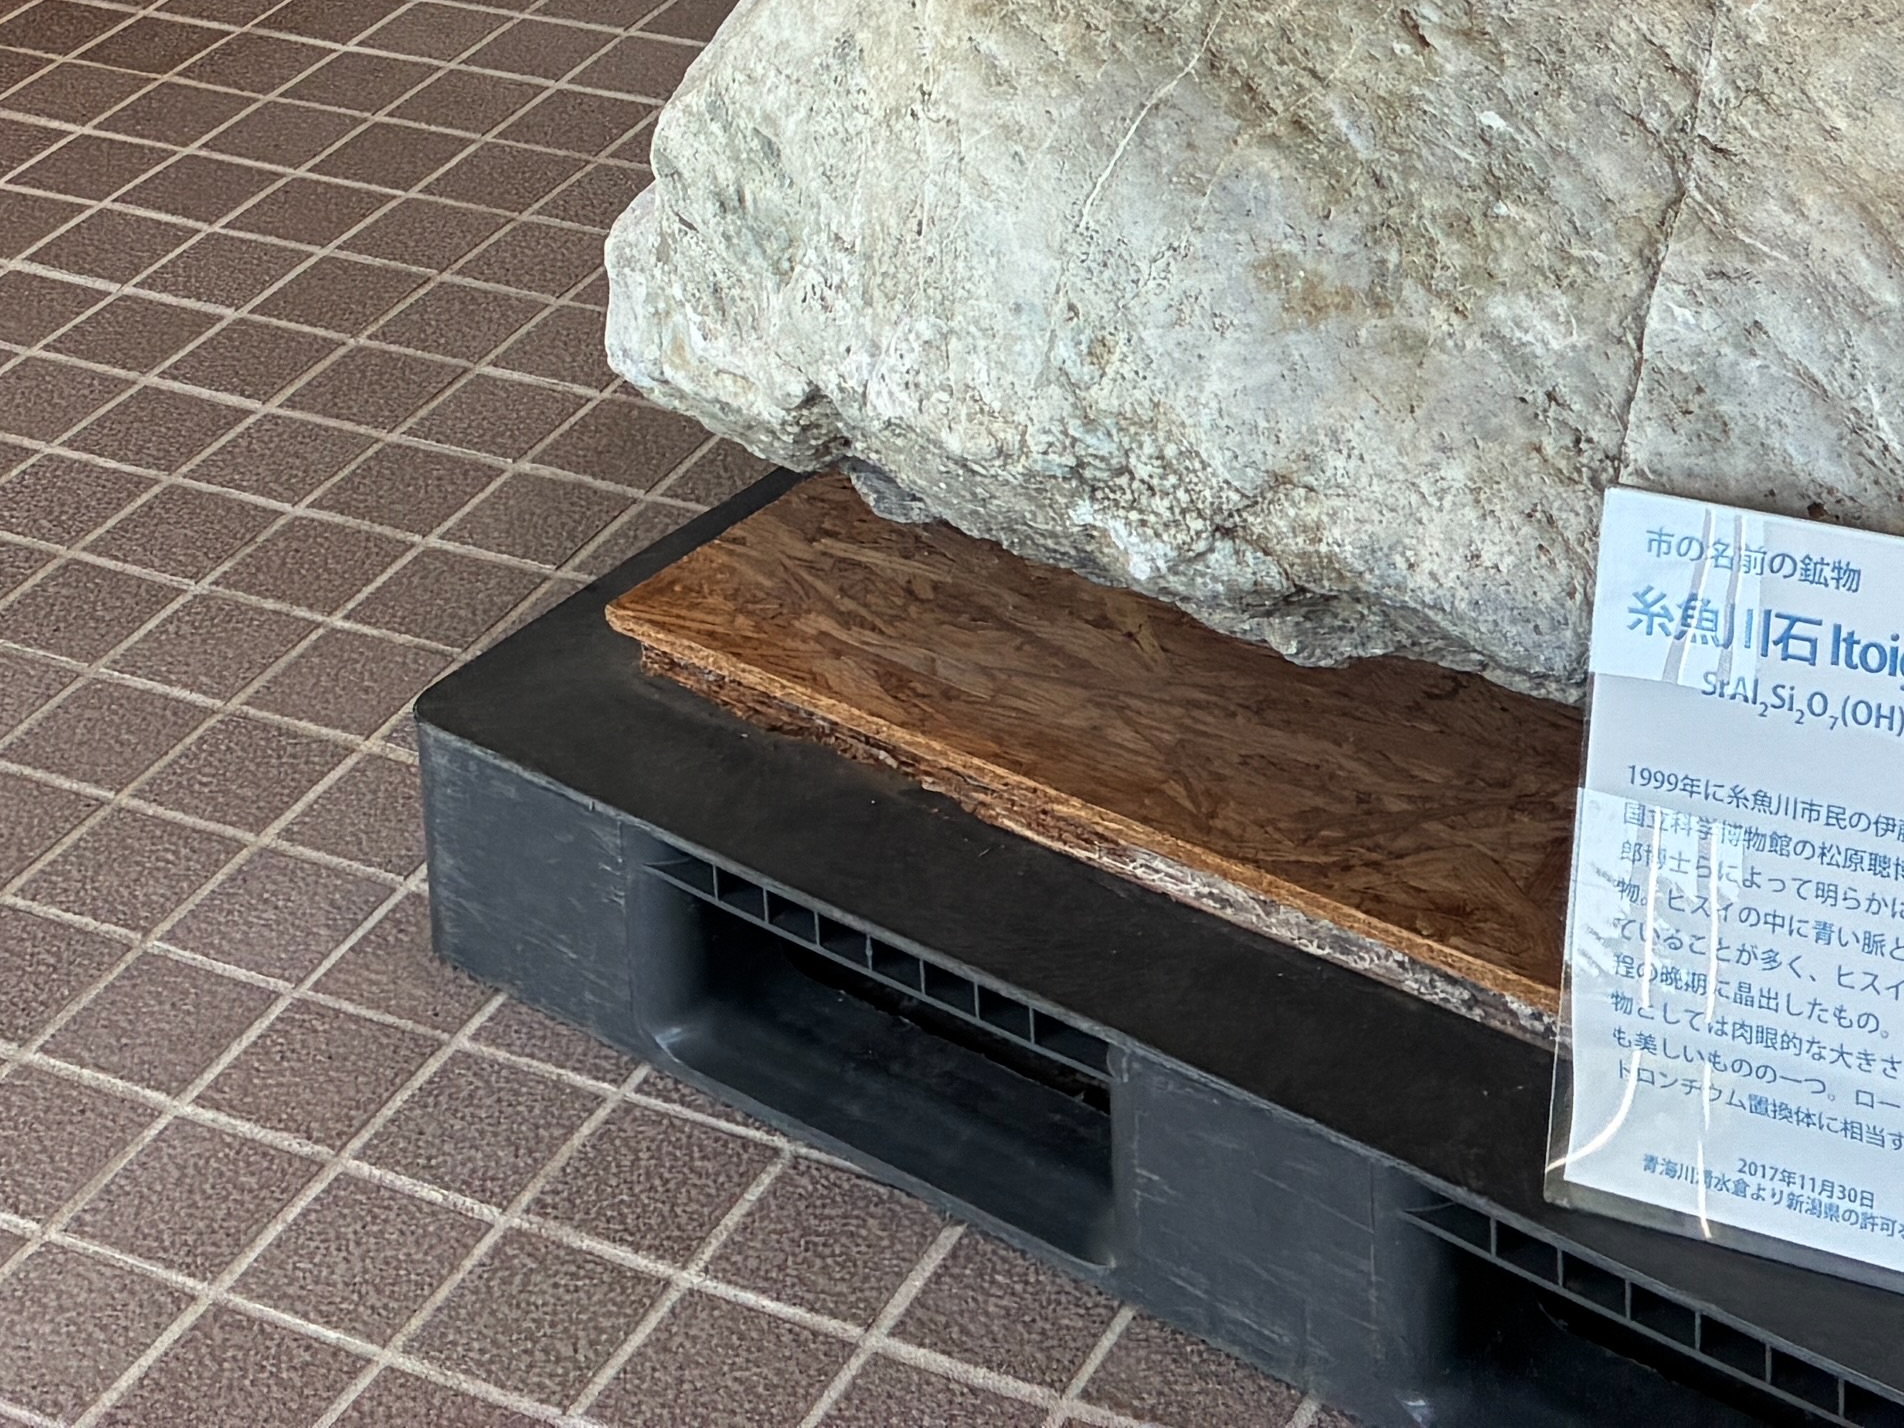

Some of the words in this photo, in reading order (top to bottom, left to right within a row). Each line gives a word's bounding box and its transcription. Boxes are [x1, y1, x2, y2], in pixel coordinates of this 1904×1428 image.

[1645, 523, 1863, 595] 市の名前の鉱物
[1626, 580, 1822, 668] 糸魚川石
[1736, 1156, 1876, 1211] 2017年11月30日
